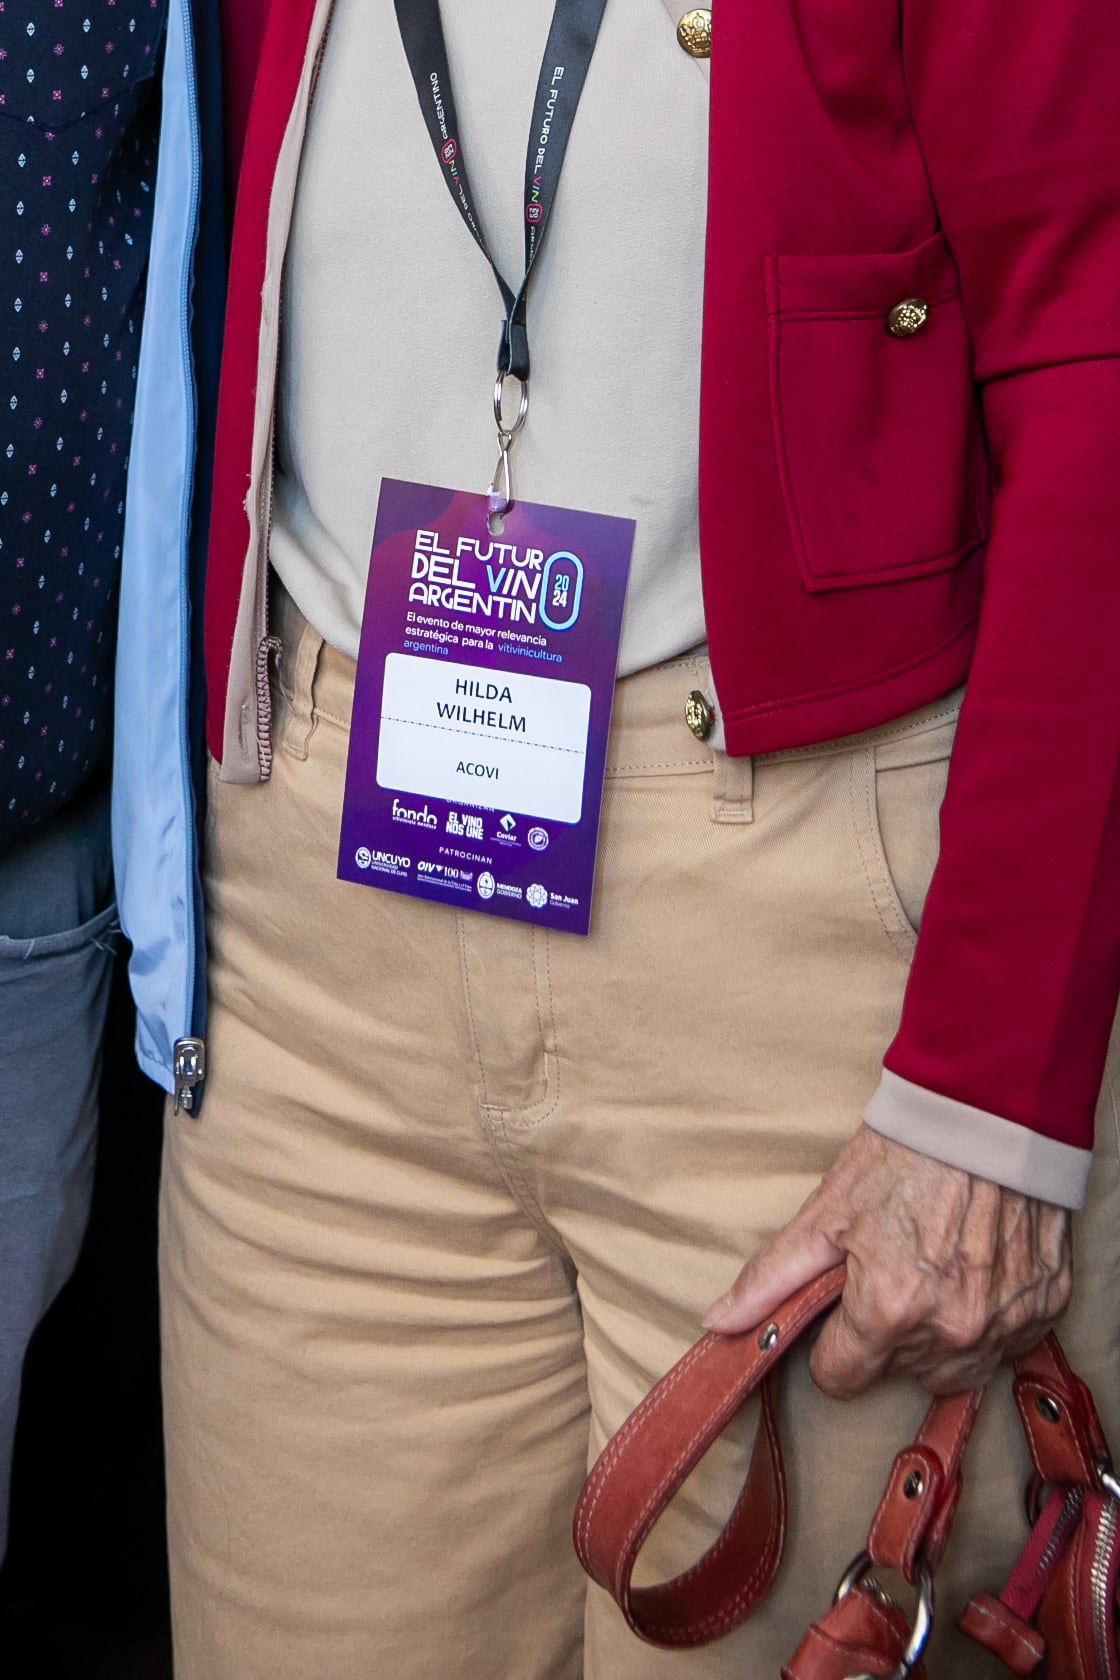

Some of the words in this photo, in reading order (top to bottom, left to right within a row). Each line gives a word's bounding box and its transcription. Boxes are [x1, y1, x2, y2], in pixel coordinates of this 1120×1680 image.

[552, 67, 564, 85] EL
[430, 72, 448, 140] ARGENTINO
[540, 89, 558, 144] FUTURO
[534, 148, 545, 174] DEL
[415, 530, 450, 555] EL
[411, 552, 475, 589] DEL
[407, 612, 416, 623] El
[417, 615, 448, 629] evento
[451, 620, 464, 631] de
[466, 624, 496, 638] mayor
[497, 629, 547, 646] relevancia
[404, 639, 449, 655] argentina
[405, 626, 459, 644] estratégica
[461, 637, 483, 649] para
[485, 639, 494, 650] la
[498, 643, 562, 663] vitivinicultura
[456, 679, 512, 703] HILDA
[437, 702, 526, 733] WILHELM
[456, 761, 499, 780] ACOVI
[392, 799, 437, 824] fondo
[449, 811, 458, 822] EL
[462, 814, 482, 828] VINO
[446, 822, 464, 836] NOS
[466, 827, 484, 840] UNE
[372, 850, 411, 868] UNCUYO
[439, 846, 492, 865] PATROCINAN
[418, 861, 435, 872] OIV
[444, 867, 459, 878] 100
[497, 883, 522, 894] MENDOZA
[551, 892, 562, 901] San
[563, 896, 579, 905] Juan
